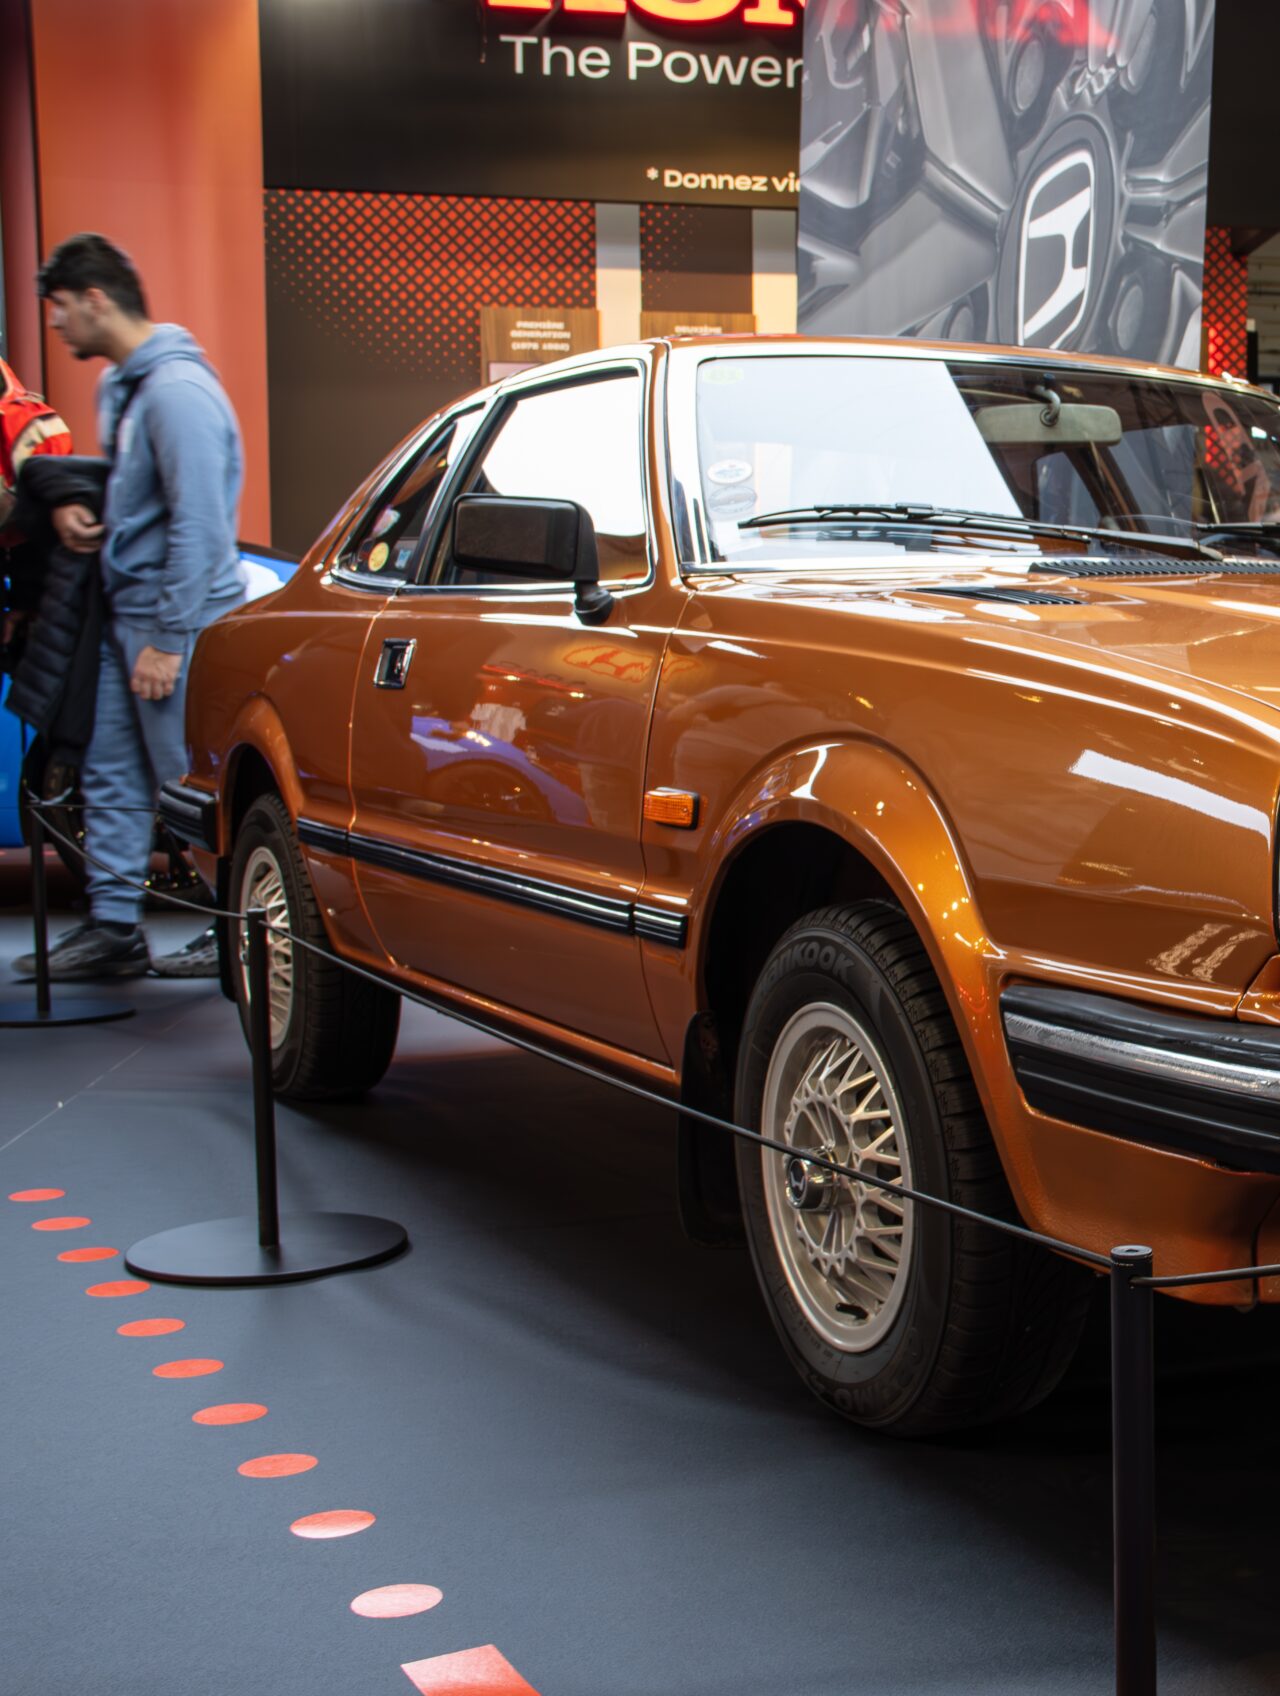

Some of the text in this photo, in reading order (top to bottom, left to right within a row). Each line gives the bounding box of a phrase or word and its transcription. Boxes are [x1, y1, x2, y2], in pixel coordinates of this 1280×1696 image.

[499, 34, 803, 88] The Power
[664, 169, 768, 192] Donnez
